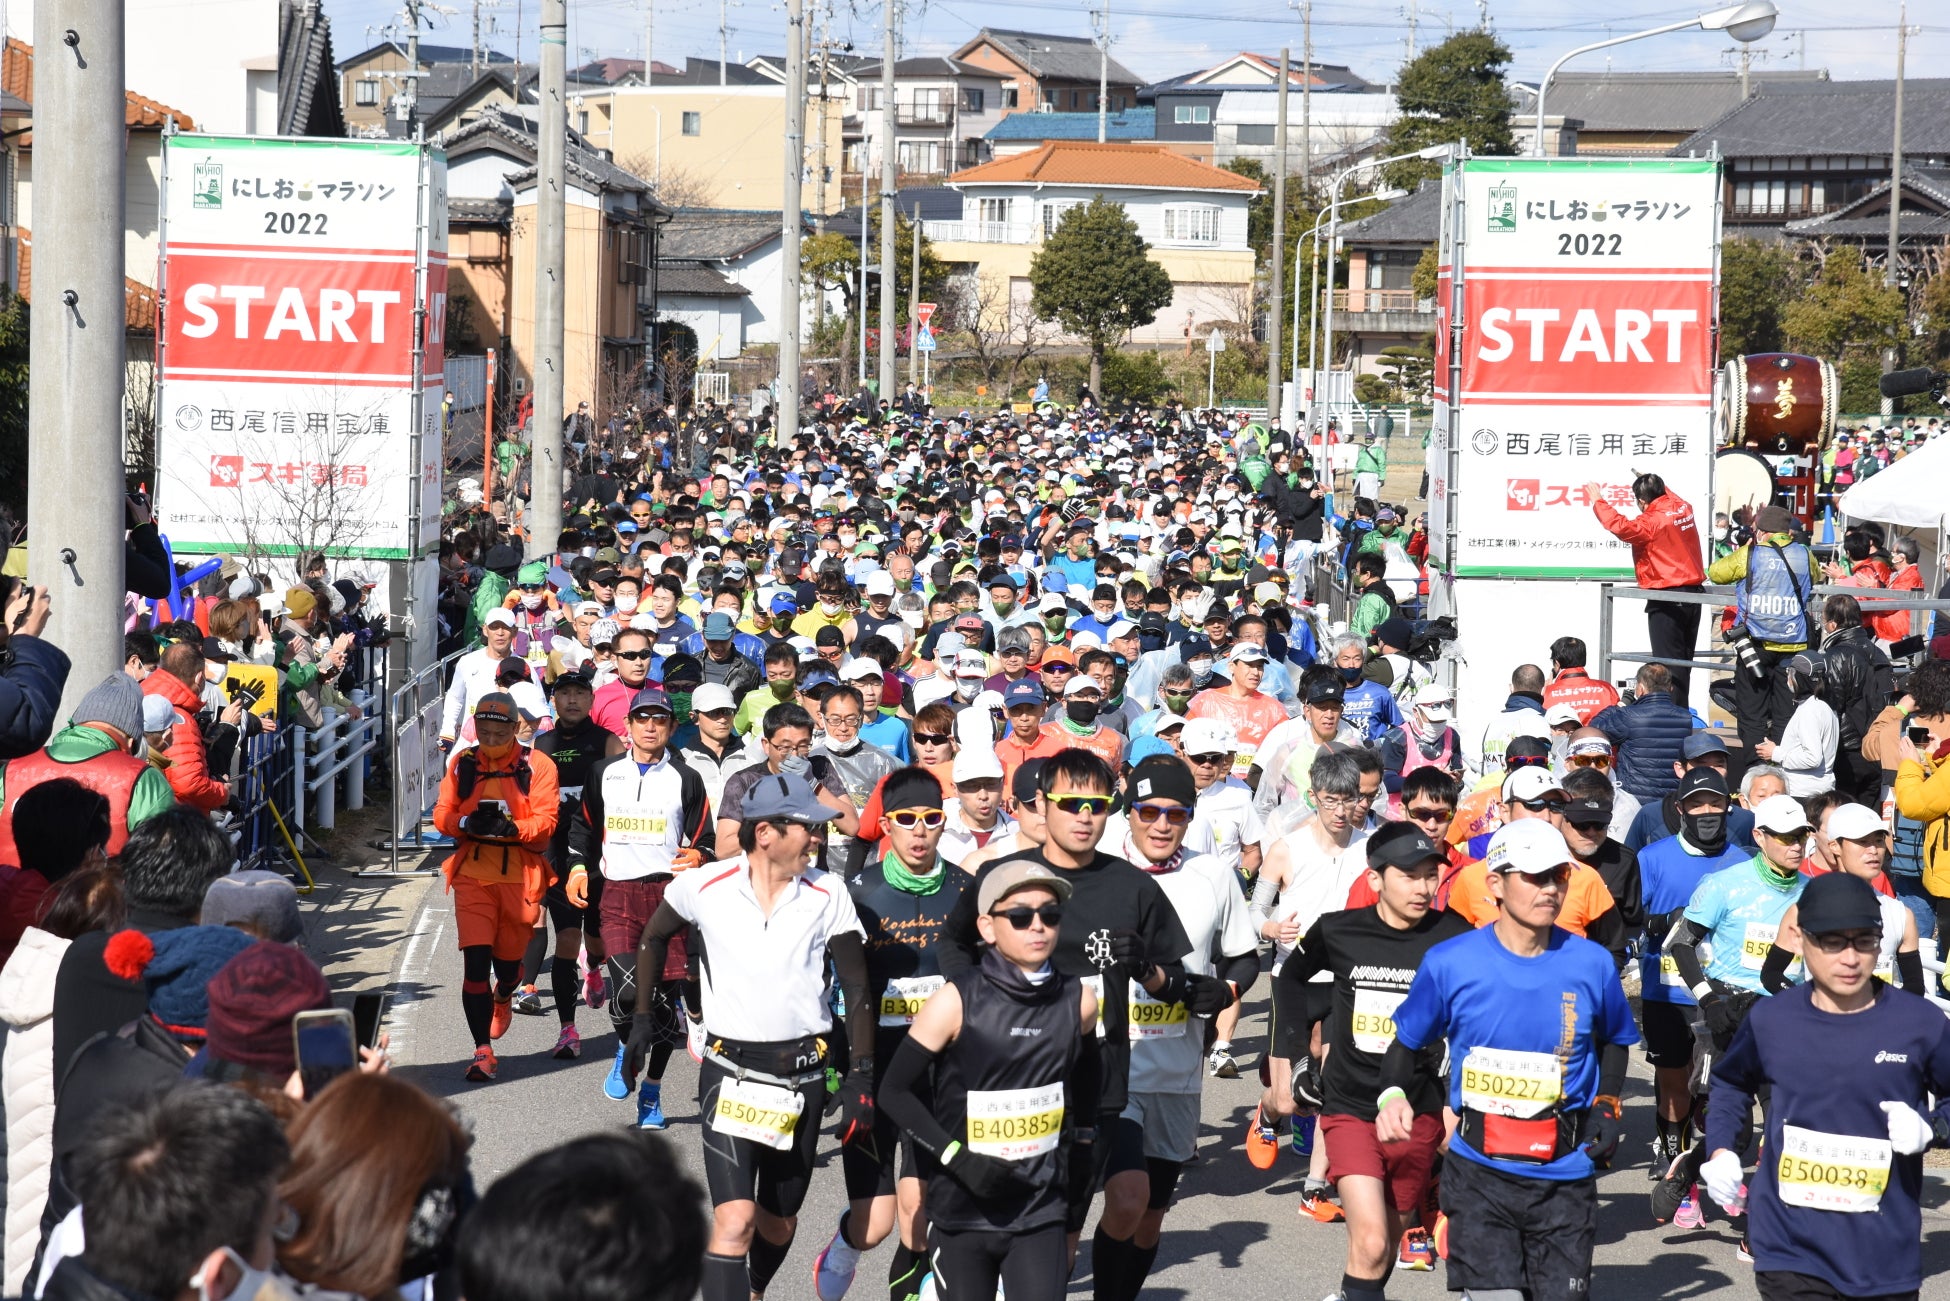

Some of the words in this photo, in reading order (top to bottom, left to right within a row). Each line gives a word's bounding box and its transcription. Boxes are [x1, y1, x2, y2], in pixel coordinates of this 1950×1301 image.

[232, 178, 396, 202] にしおマラソン
[1527, 199, 1691, 222] にしおマラソン
[264, 211, 328, 235] 2022
[1558, 233, 1623, 256] 2022
[181, 283, 401, 344] START
[1478, 307, 1697, 363] START
[210, 408, 392, 436] 西尾信用金庫
[1506, 432, 1689, 456] 西尾信用金庫
[248, 460, 368, 487] スギ薬局
[1545, 482, 1636, 507] スギ薬
[1750, 594, 1799, 616] PHOTO
[1236, 755, 1253, 764] 867
[607, 817, 653, 831] B60311
[1745, 940, 1773, 957] B50
[884, 999, 928, 1015] B30
[1132, 1003, 1175, 1022] 0997
[1356, 1014, 1393, 1034] B30
[1880, 1052, 1908, 1063] asics
[1466, 1071, 1541, 1099] B50227
[721, 1100, 790, 1129] B50779
[973, 1113, 1049, 1139] B40385
[1781, 1157, 1868, 1189] B50038
